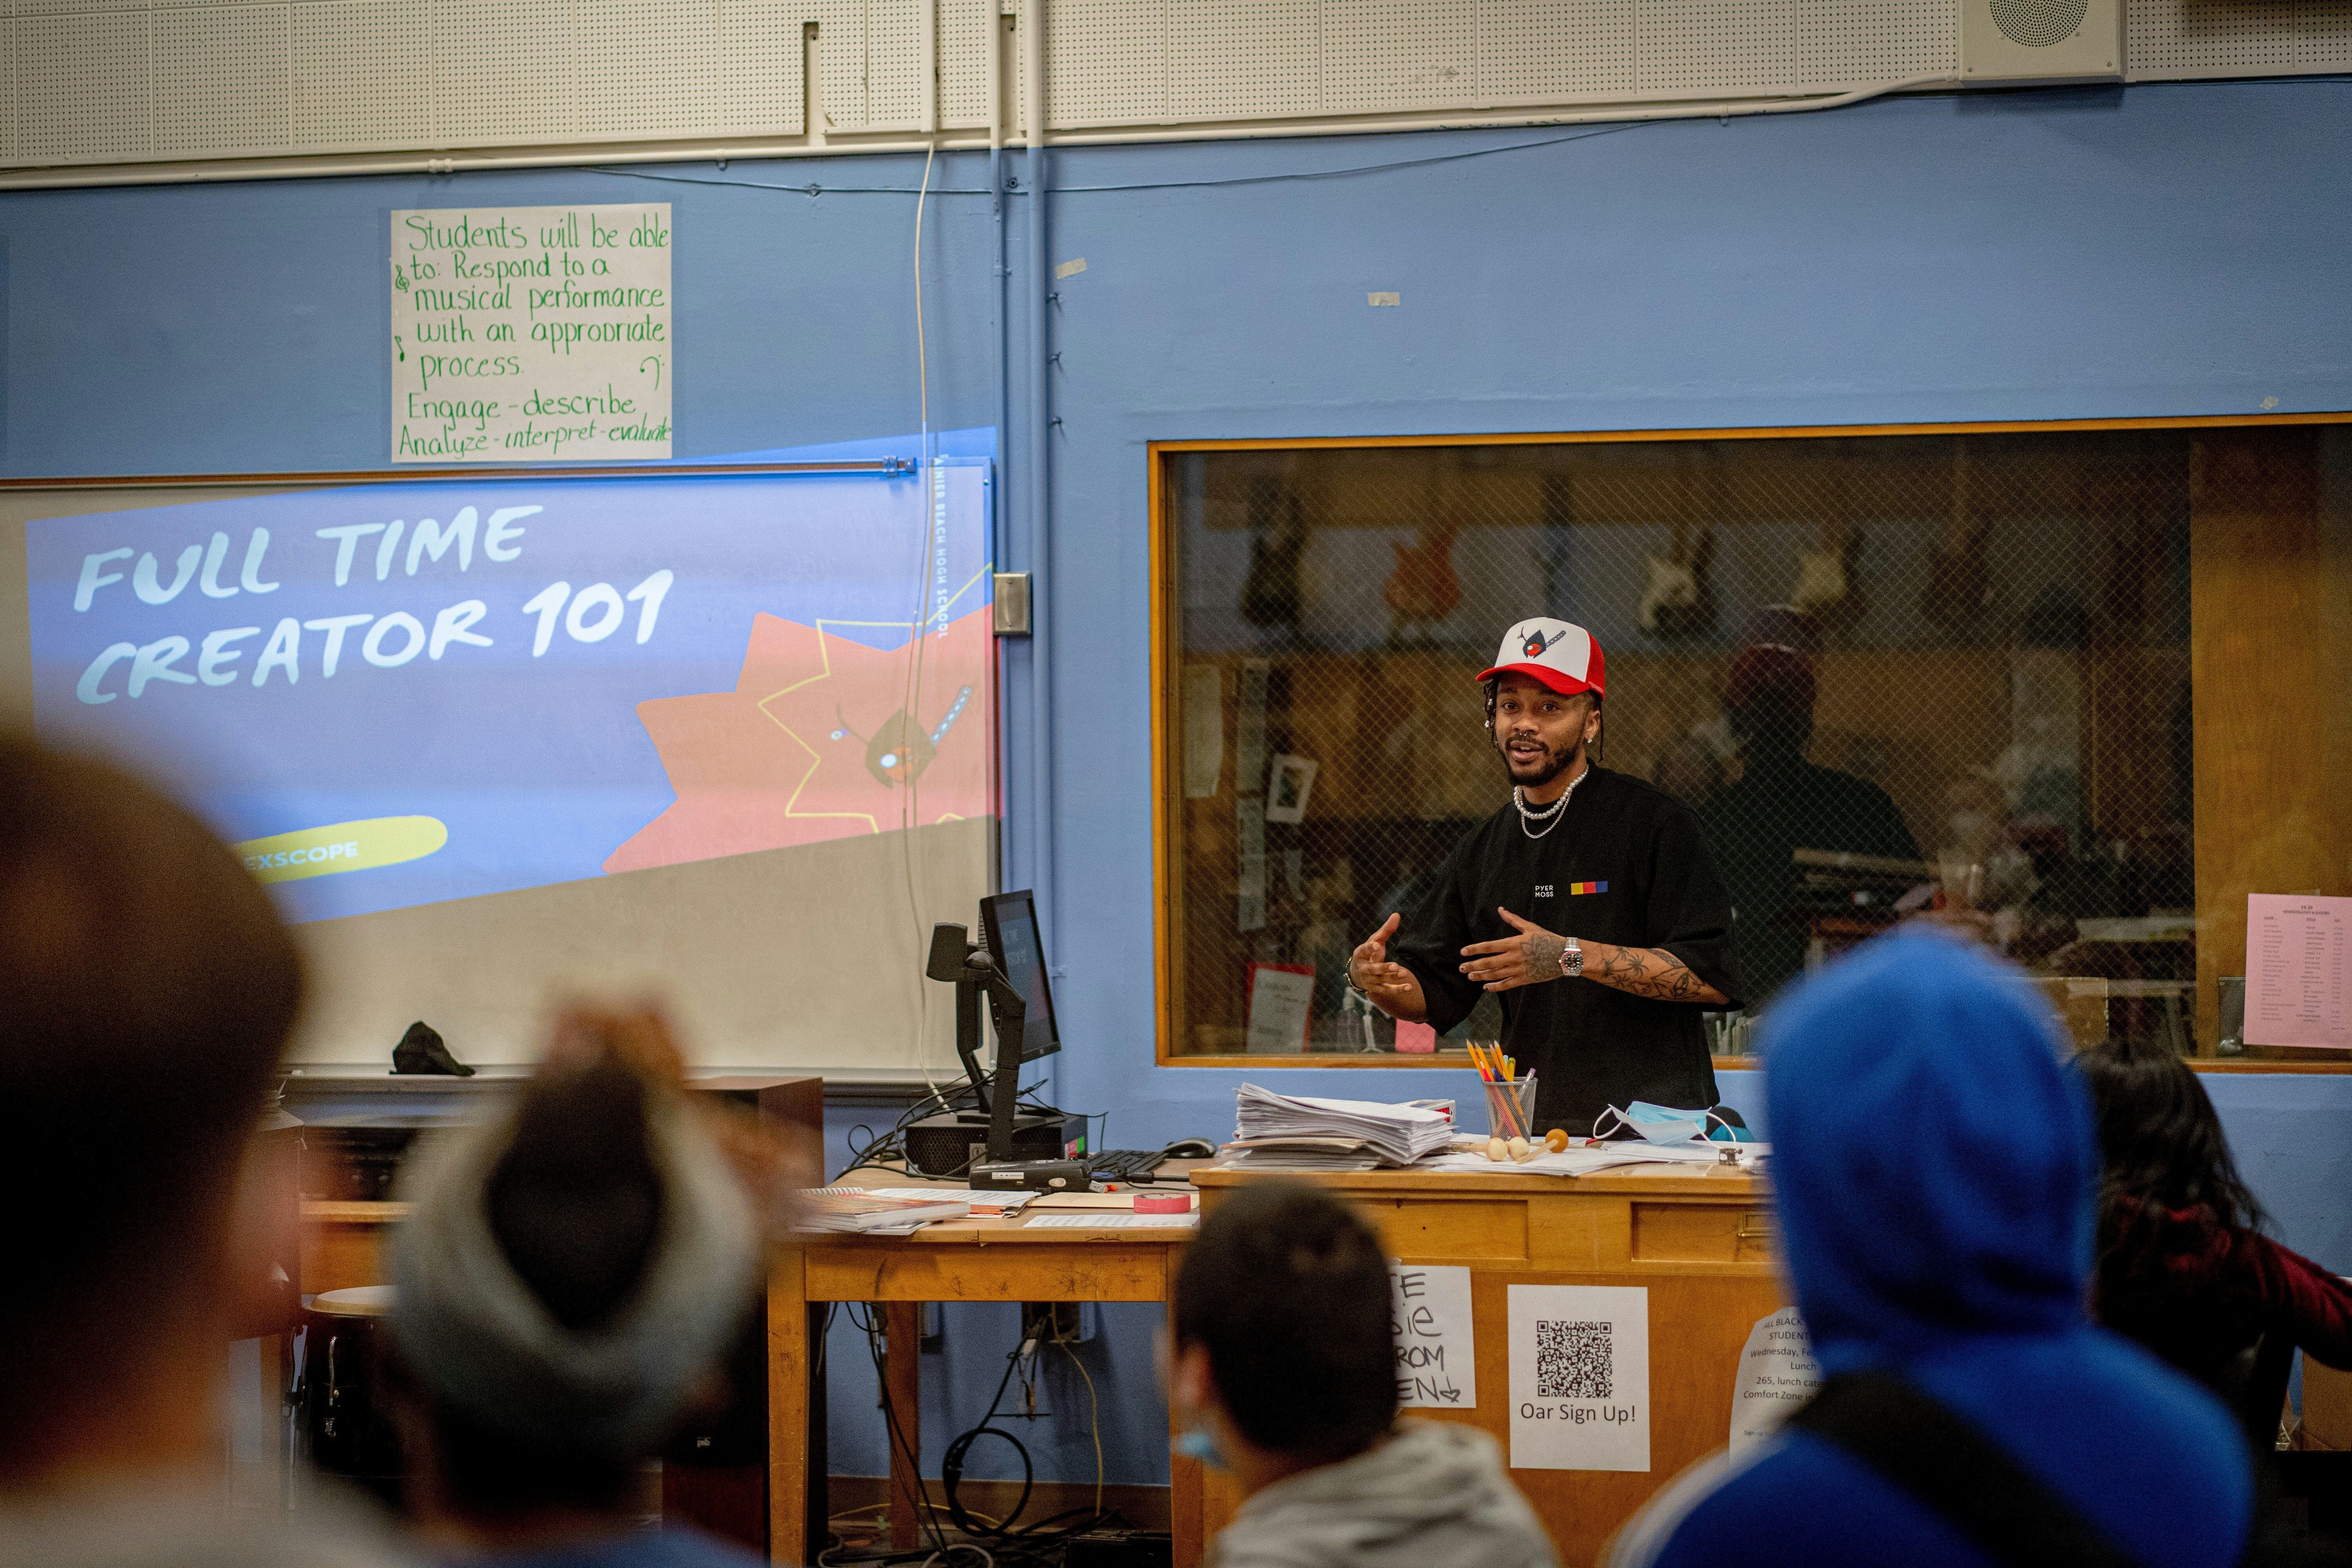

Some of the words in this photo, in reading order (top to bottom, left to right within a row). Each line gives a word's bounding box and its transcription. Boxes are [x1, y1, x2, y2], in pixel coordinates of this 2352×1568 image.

[406, 214, 528, 251] Students
[540, 212, 579, 248] will
[591, 213, 619, 248] be
[629, 212, 668, 248] able
[452, 250, 550, 289] Respond
[560, 251, 584, 277] to
[592, 258, 612, 276] a
[415, 283, 512, 311] musical
[530, 279, 664, 321] performance
[417, 314, 475, 343] with
[486, 323, 516, 343] an
[935, 503, 946, 544] BEACH
[73, 526, 280, 612] FULL
[316, 505, 543, 587] TIME
[936, 589, 949, 638] SCHOOL
[76, 599, 494, 705] CREATOR
[523, 569, 673, 658] 101
[1776, 1318, 1802, 1326] BLACK
[1751, 1348, 1799, 1357] Wednesday,
[1791, 1362, 1816, 1370] Lunch
[1744, 1390, 1779, 1399] Comfort
[1781, 1391, 1803, 1400] Zone
[1756, 1376, 1775, 1386] 265,
[1778, 1377, 1801, 1386] lunch
[1521, 1403, 1553, 1419] Oar
[1559, 1403, 1596, 1425] Sign
[1603, 1405, 1636, 1426] Up!
